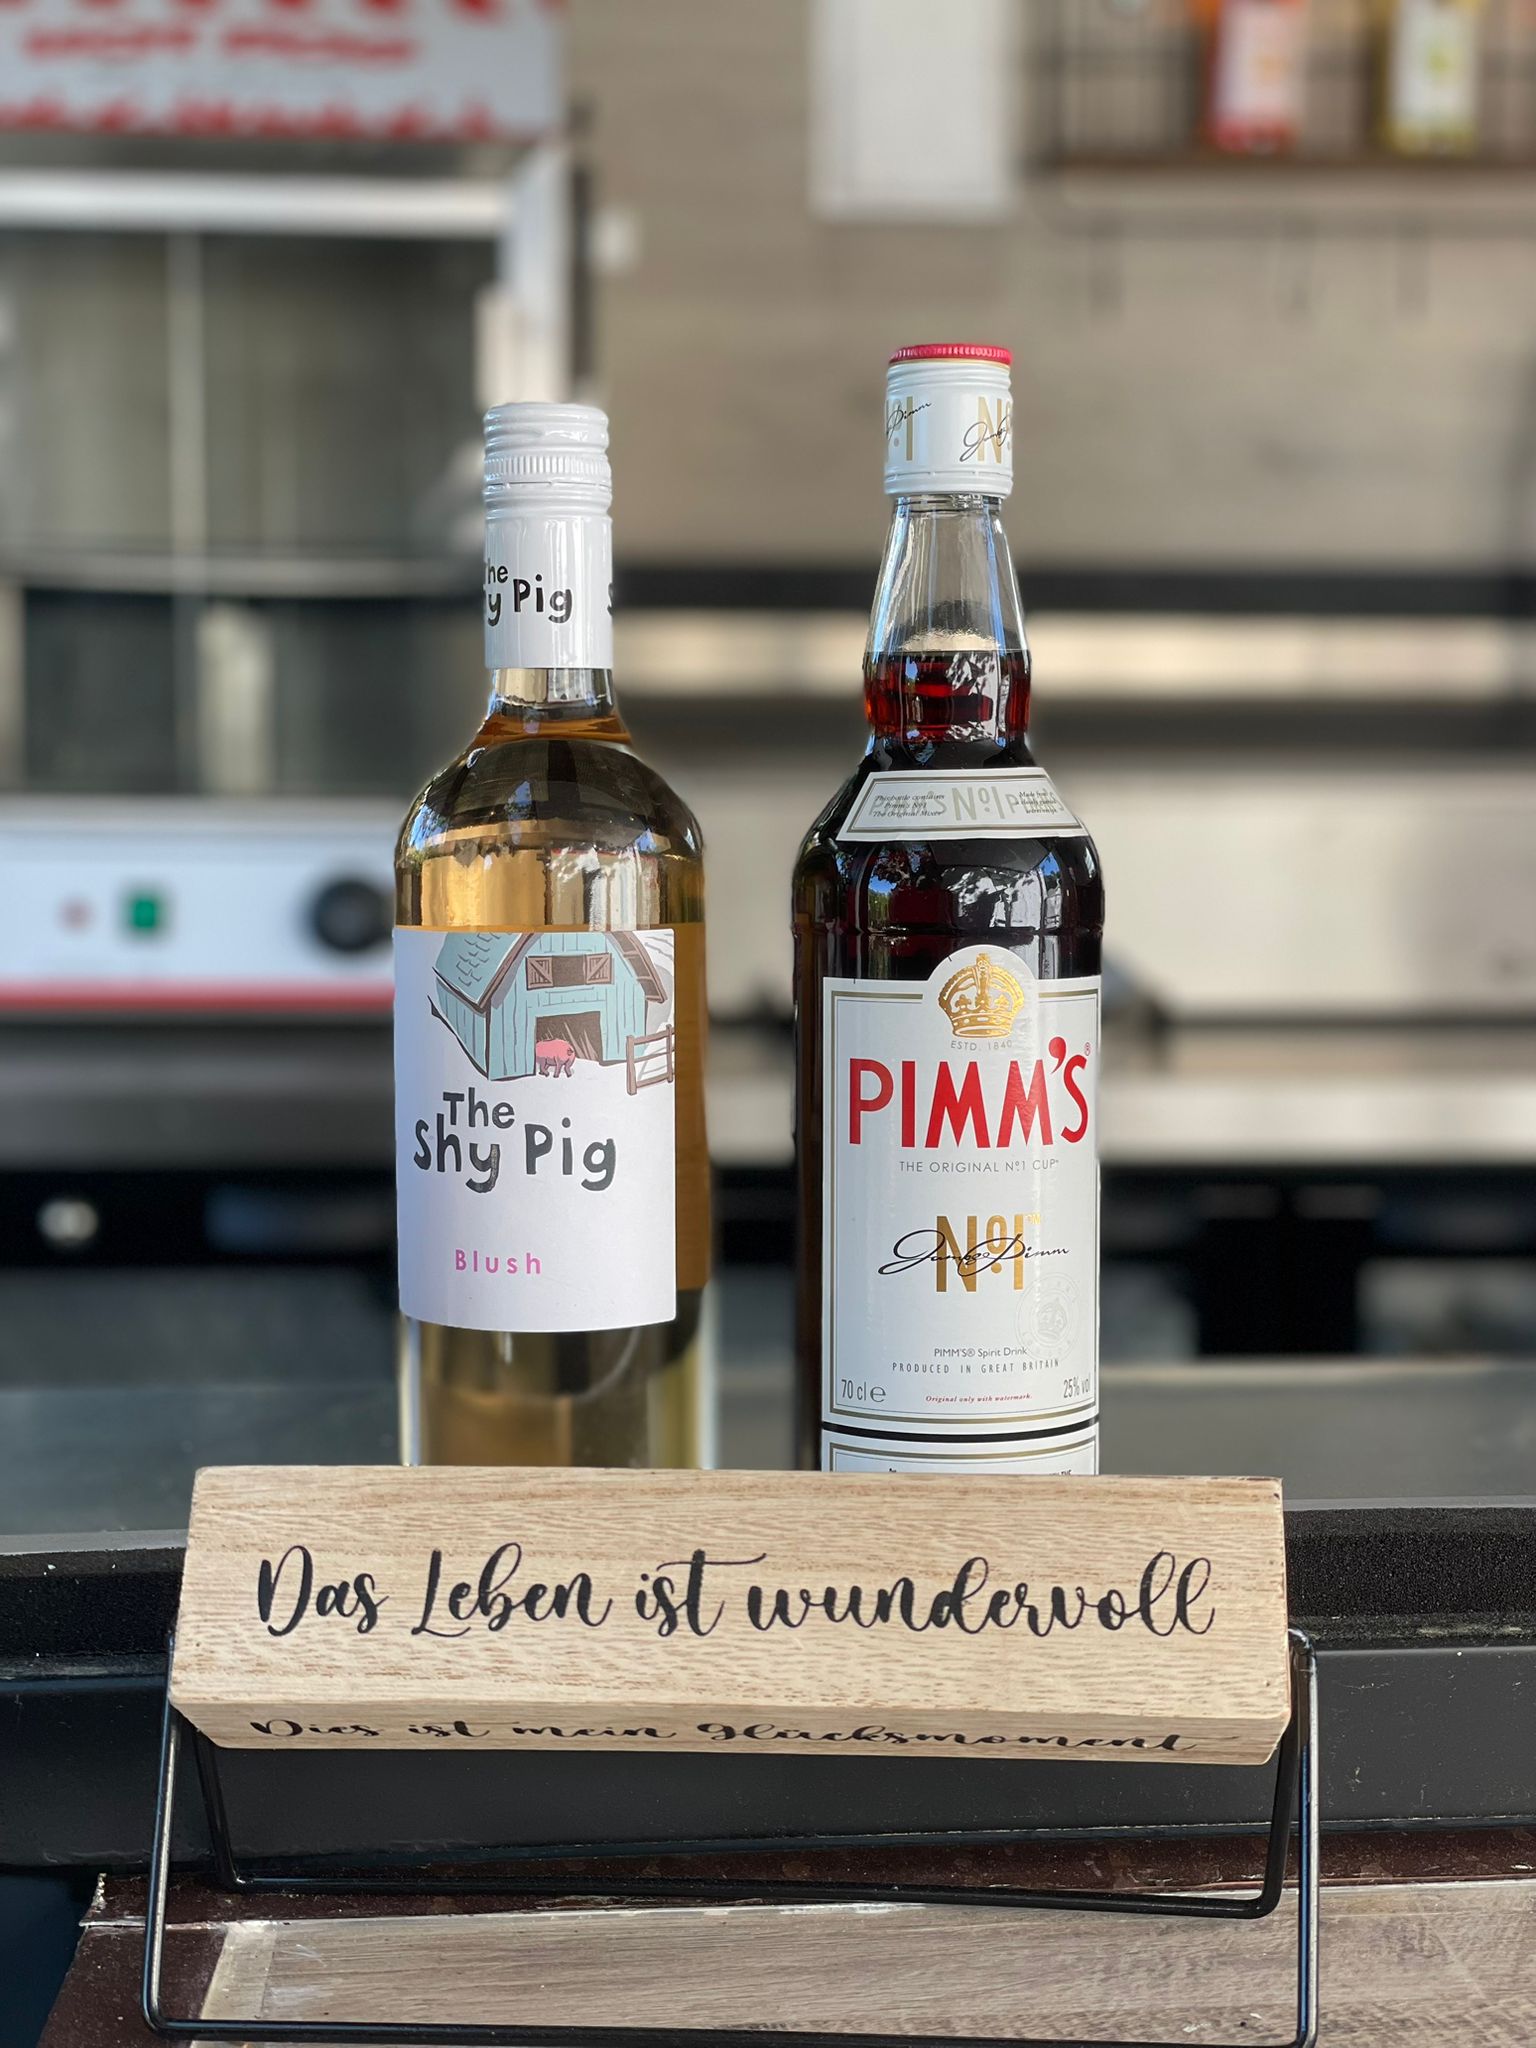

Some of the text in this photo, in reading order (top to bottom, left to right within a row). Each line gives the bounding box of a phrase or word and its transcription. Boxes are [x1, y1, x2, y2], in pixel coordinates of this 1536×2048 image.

[513, 573, 573, 624] Pig
[443, 1087, 515, 1129] The
[413, 1113, 617, 1193] Shy Pig
[900, 1161, 923, 1173] THE
[929, 1161, 999, 1173] ORIGINAL
[455, 1249, 542, 1275] Blush
[977, 1347, 1001, 1359] Spirit
[1003, 1346, 1028, 1357] Drink
[892, 1359, 1060, 1374] PRODUCED IN GREAT BRITAIN
[841, 1379, 853, 1399] 70
[857, 1381, 867, 1401] cl
[1063, 1377, 1080, 1399] 25%
[925, 1395, 957, 1404] Original
[959, 1396, 975, 1404] only
[257, 1542, 1216, 1638] Das Leben ist wundervoll
[249, 1718, 383, 1738] Dies
[408, 1720, 521, 1738] ist
[512, 1724, 677, 1739] mein
